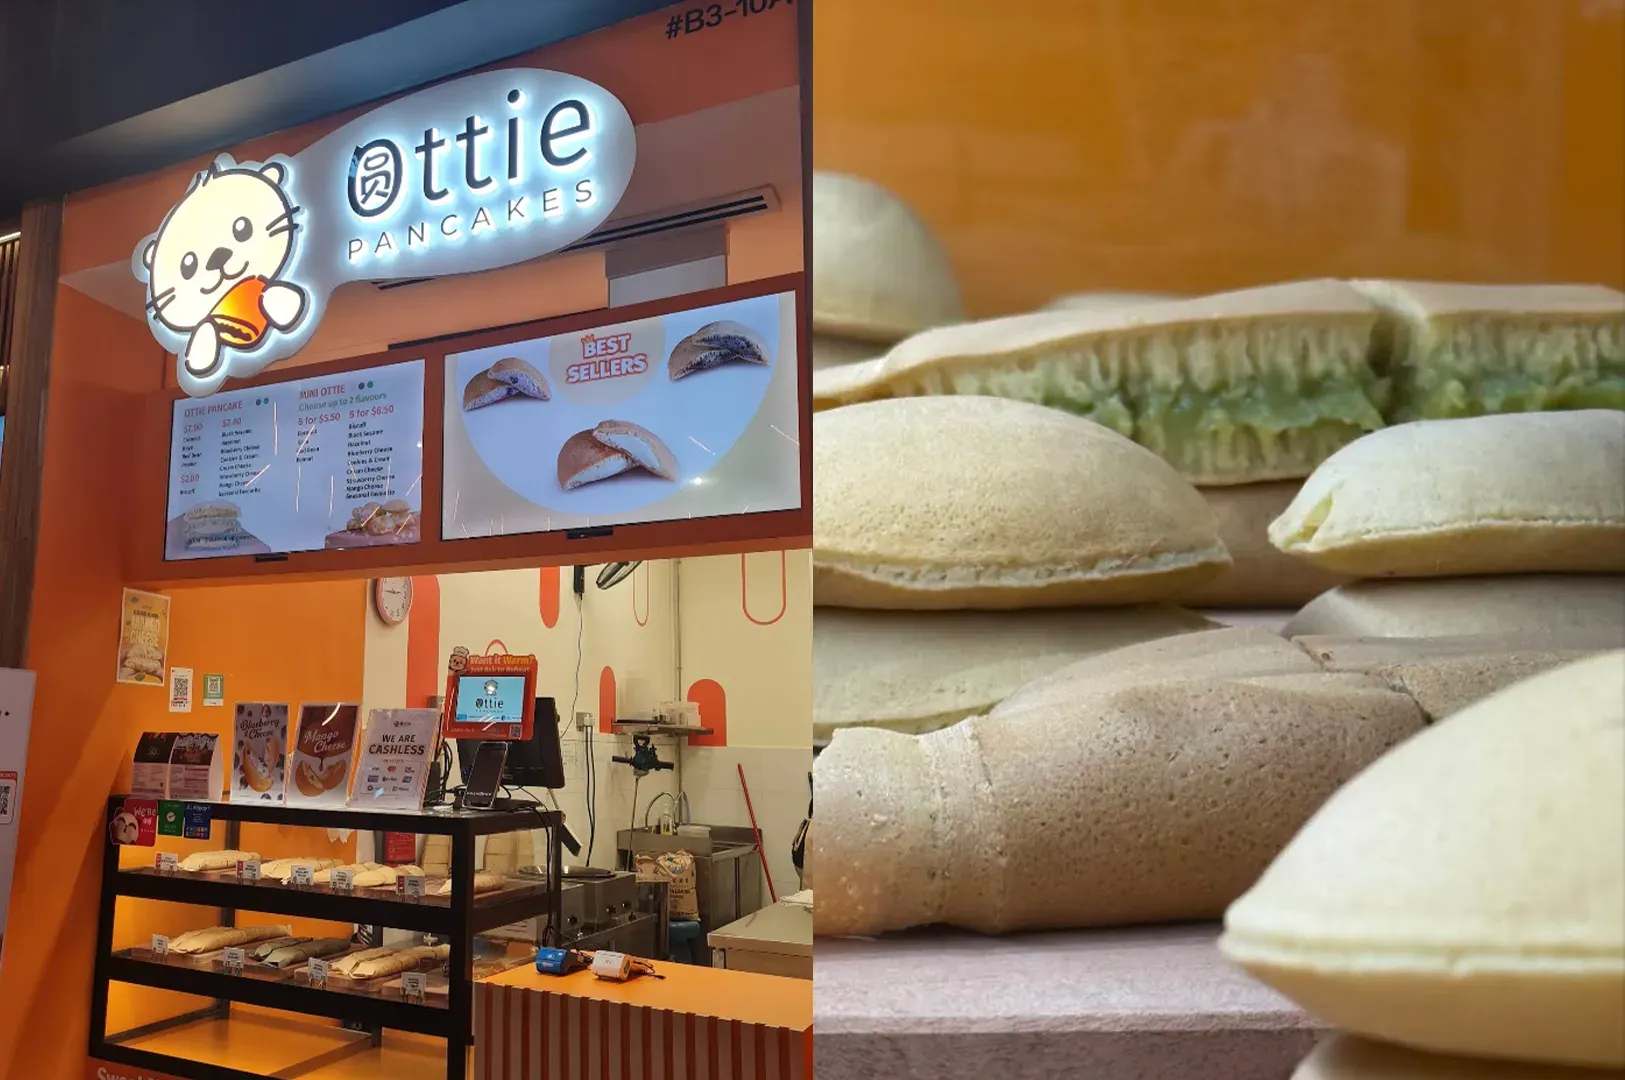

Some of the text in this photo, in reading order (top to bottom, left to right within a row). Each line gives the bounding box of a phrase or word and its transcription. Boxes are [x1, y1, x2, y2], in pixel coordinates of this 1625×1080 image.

[348, 89, 591, 218] Ottie
[348, 179, 592, 260] PANCAKES
[583, 332, 632, 359] BEST
[566, 353, 648, 384] SELLERS
[299, 384, 346, 400] MINI OTTIE
[299, 392, 387, 412] Choose up to 2 flavours
[184, 401, 243, 418] OTTIE PANCAKE
[349, 410, 355, 419] 6
[356, 408, 369, 418] for
[305, 416, 317, 425] for
[348, 429, 384, 439] Black Sesame
[374, 446, 393, 454] Cheese
[346, 485, 364, 493] Mango
[470, 653, 534, 665] Want it Warm?
[475, 697, 504, 709] Ottie
[240, 719, 280, 730] Blueberry
[248, 729, 273, 740] Cheese
[304, 730, 340, 743] Mango
[382, 734, 416, 743] WE ARE
[313, 741, 347, 753] Cheese
[368, 744, 425, 756] CASHLESS
